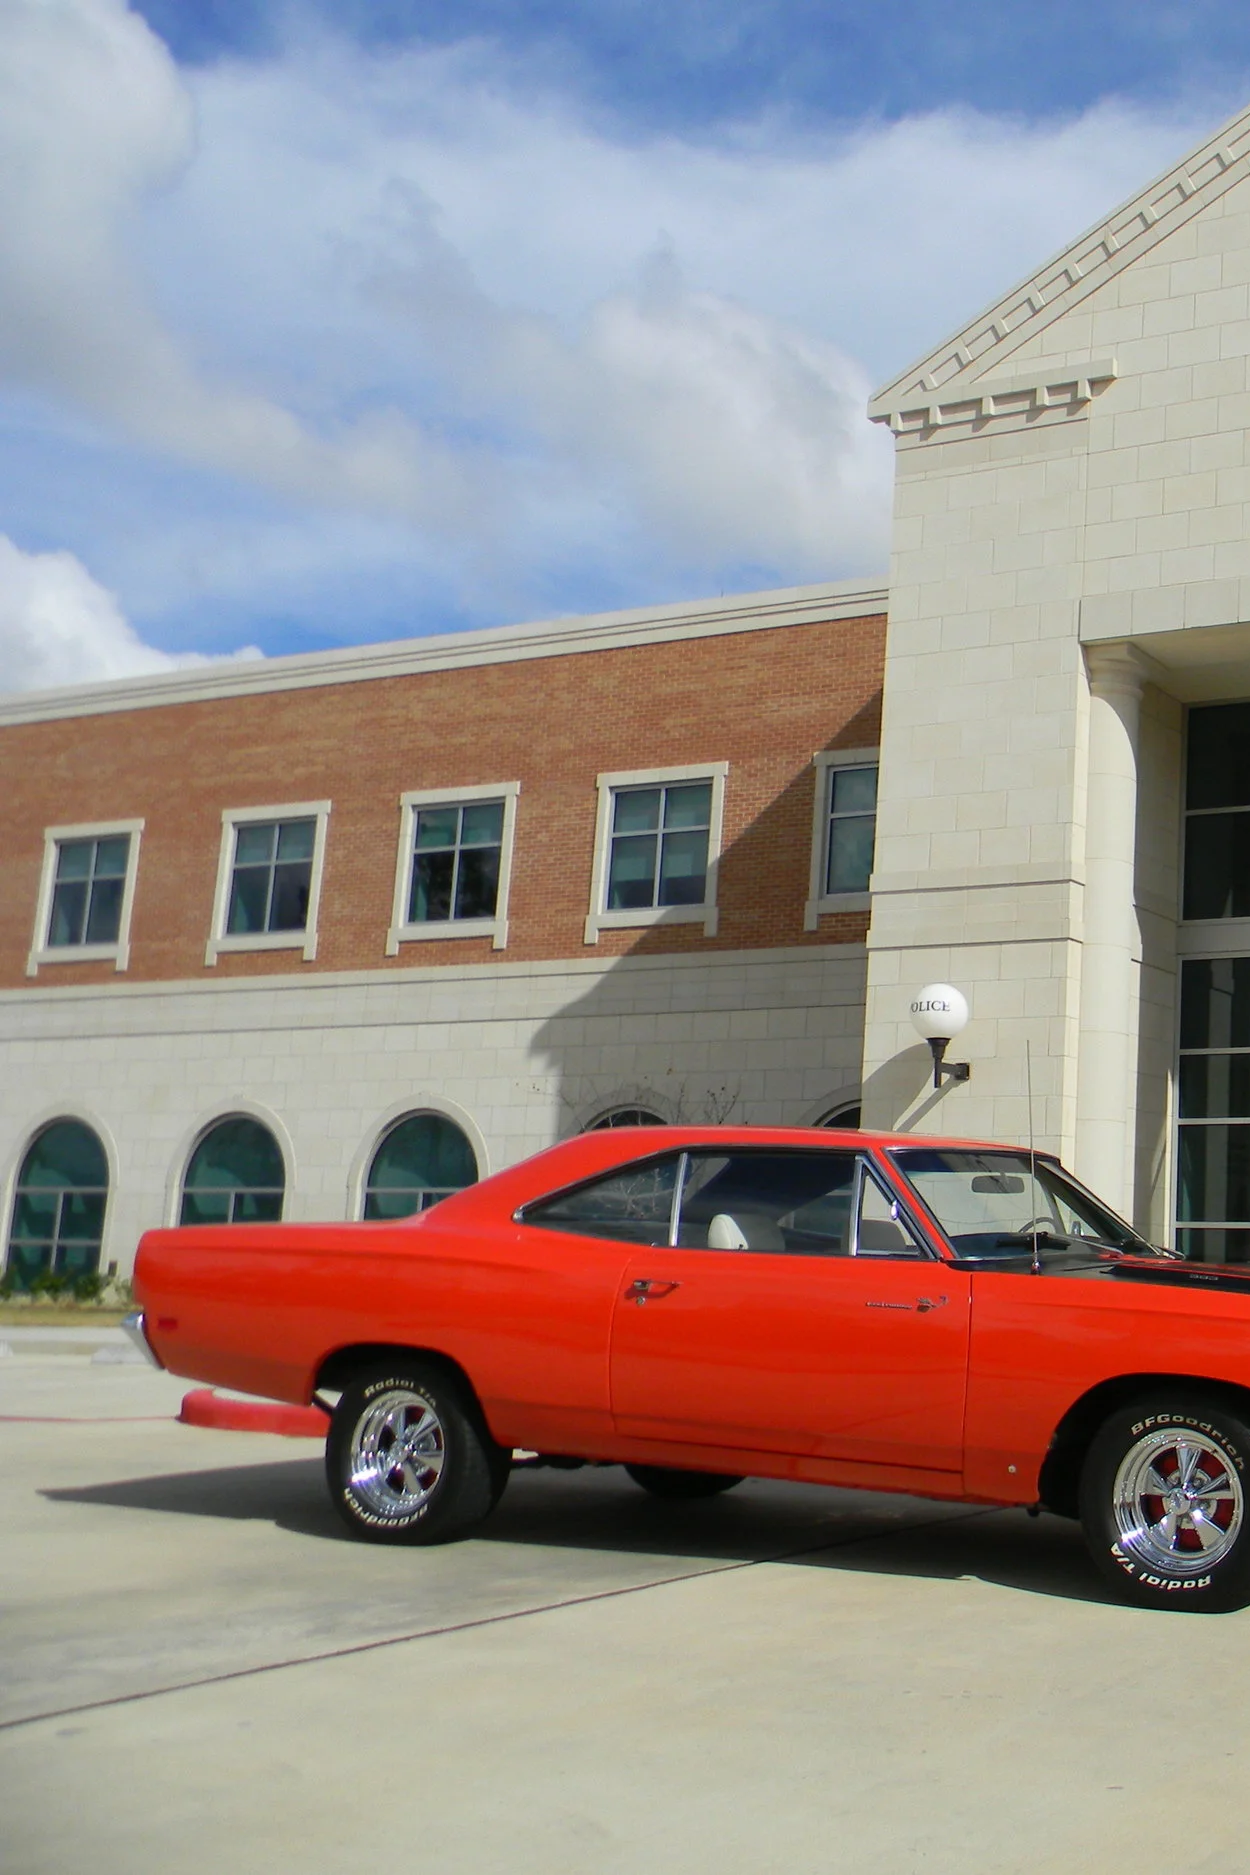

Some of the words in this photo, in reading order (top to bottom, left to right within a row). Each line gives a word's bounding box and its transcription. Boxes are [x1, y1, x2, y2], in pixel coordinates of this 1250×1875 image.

[910, 1000, 951, 1013] OLICE
[1131, 1413, 1245, 1470] BFGoodrich
[1110, 1542, 1136, 1574] T/A
[1138, 1572, 1212, 1590] Radial
